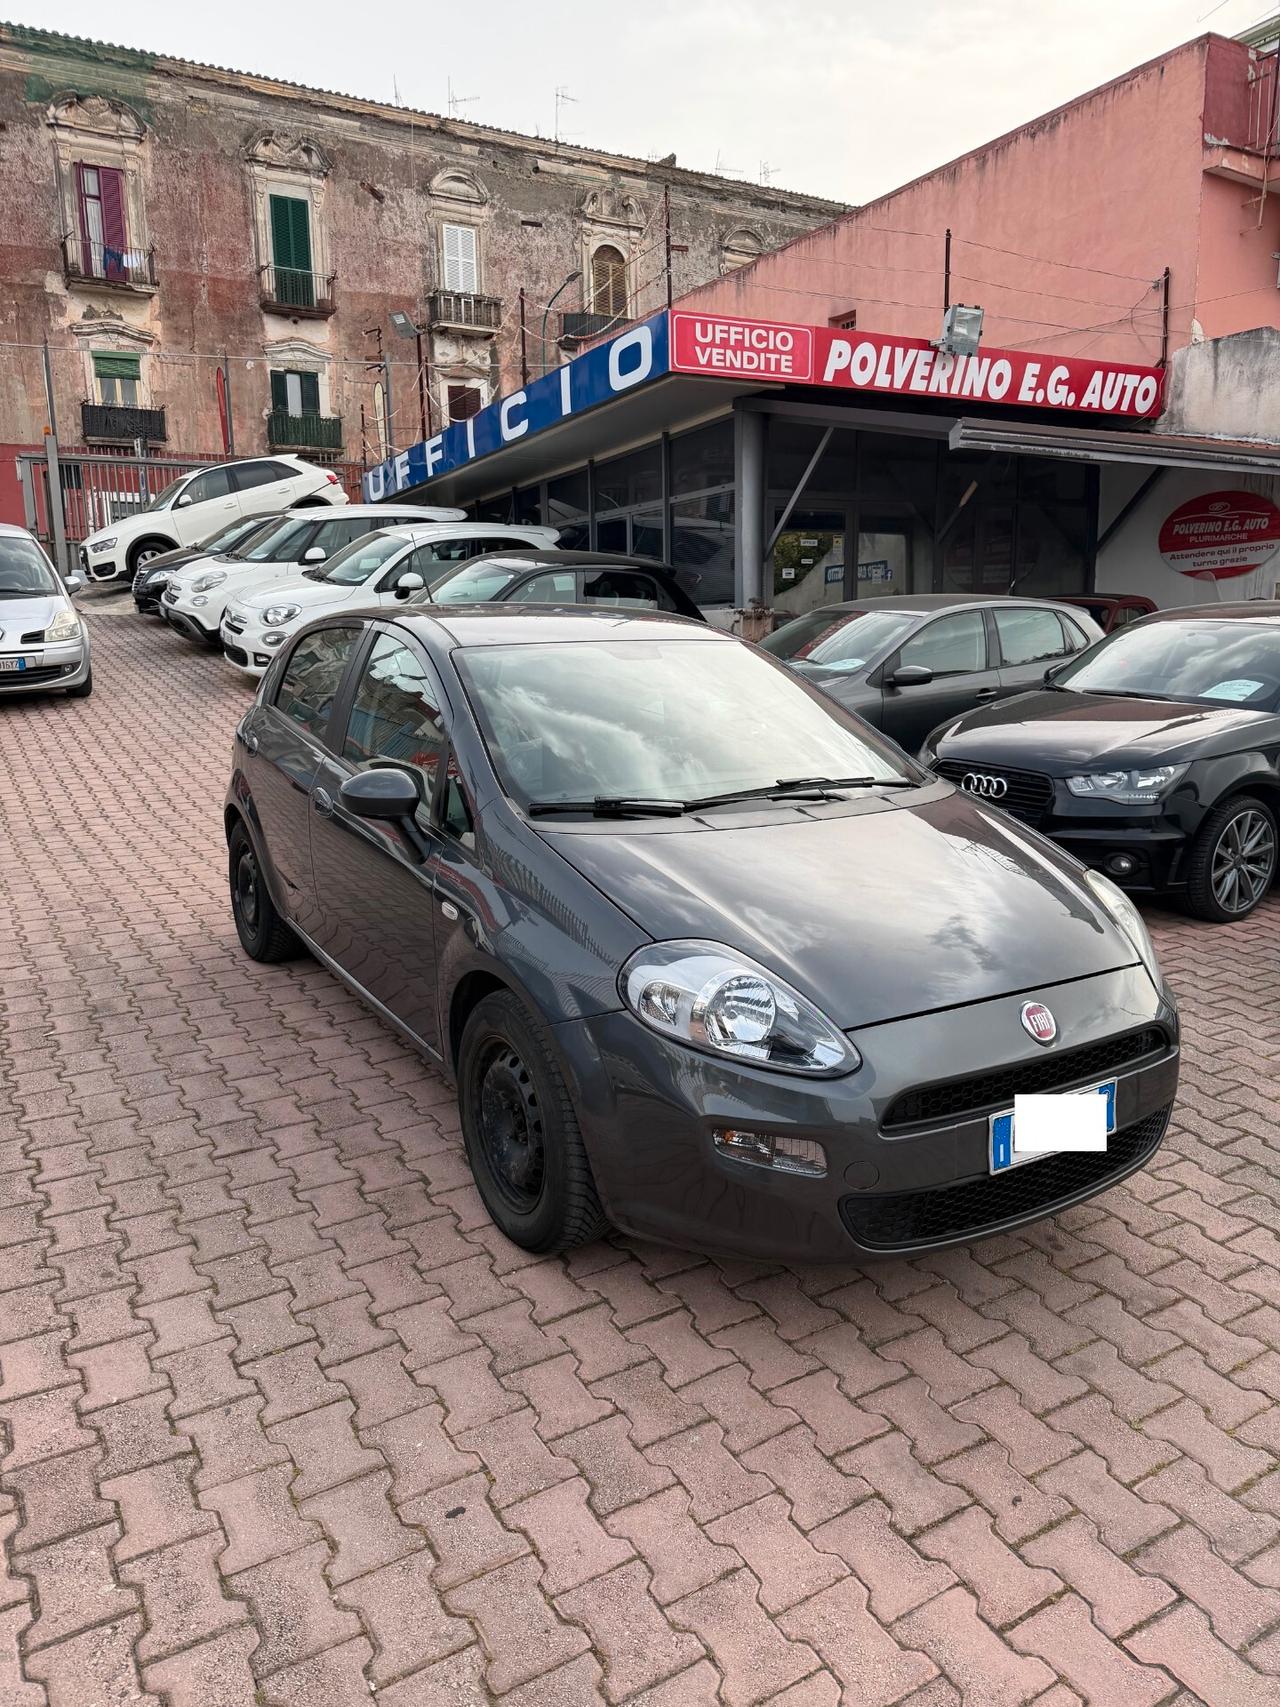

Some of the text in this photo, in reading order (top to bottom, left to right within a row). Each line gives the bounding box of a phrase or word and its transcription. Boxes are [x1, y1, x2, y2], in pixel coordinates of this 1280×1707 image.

[695, 322, 793, 351] UFFICIO
[695, 346, 793, 373] VENDITE
[823, 339, 1158, 415] POLVERINO E.G. AUTO
[369, 325, 652, 502] UFFICIO
[1173, 517, 1269, 535] POLVERINO E.G. AUTO
[1189, 532, 1248, 543] PLURIMARCHE
[1170, 549, 1216, 560] Attendere
[1217, 546, 1231, 557] qui
[1192, 555, 1248, 568] turno grazie
[1029, 1013, 1051, 1033] FIAT
